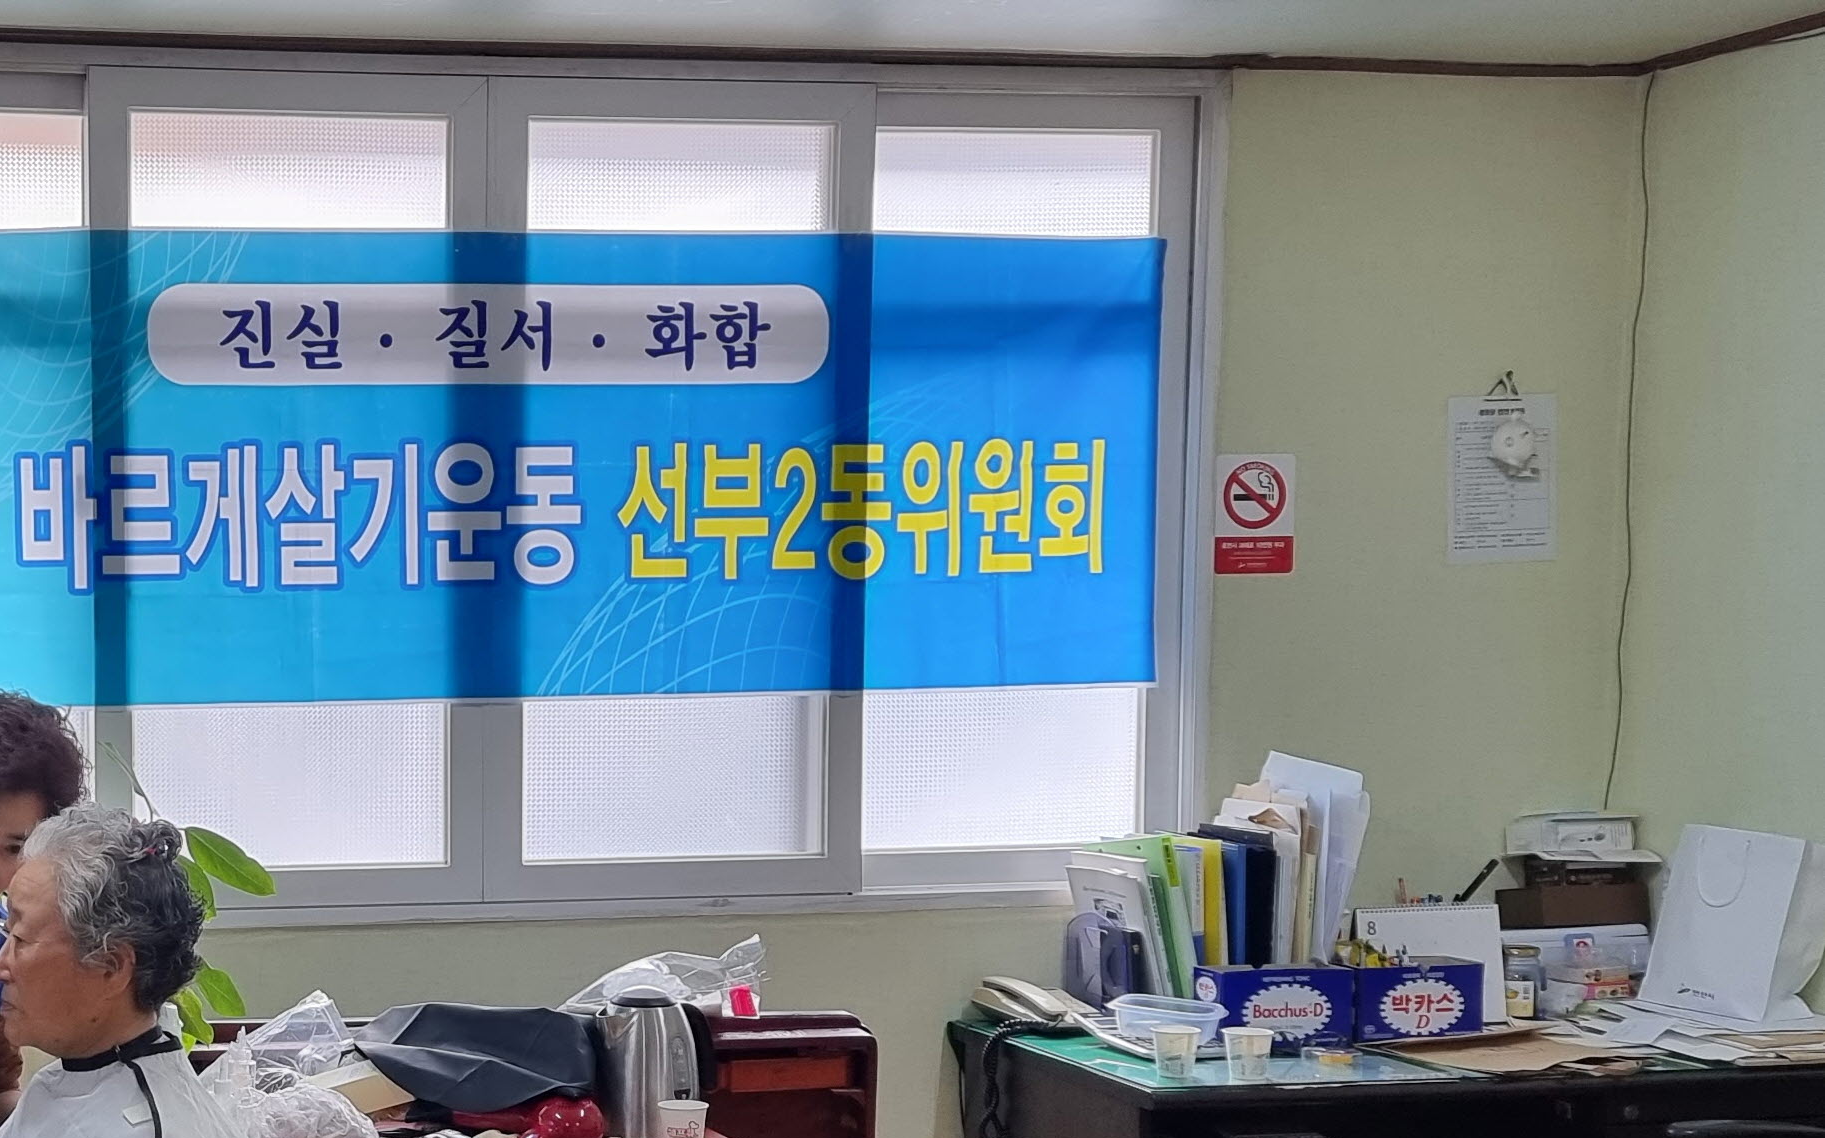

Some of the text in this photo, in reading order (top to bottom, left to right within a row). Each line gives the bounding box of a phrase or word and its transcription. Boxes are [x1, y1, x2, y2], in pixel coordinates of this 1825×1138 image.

[219, 299, 345, 371] 진실
[434, 299, 553, 373] 질서
[643, 298, 773, 373] 화합
[17, 438, 1106, 591] 바르게살기운동 선부2동위원회
[1367, 921, 1377, 936] 8
[1252, 1001, 1325, 1019] Bacchus-D
[1391, 993, 1455, 1014] 박카스
[1415, 1014, 1431, 1029] D
